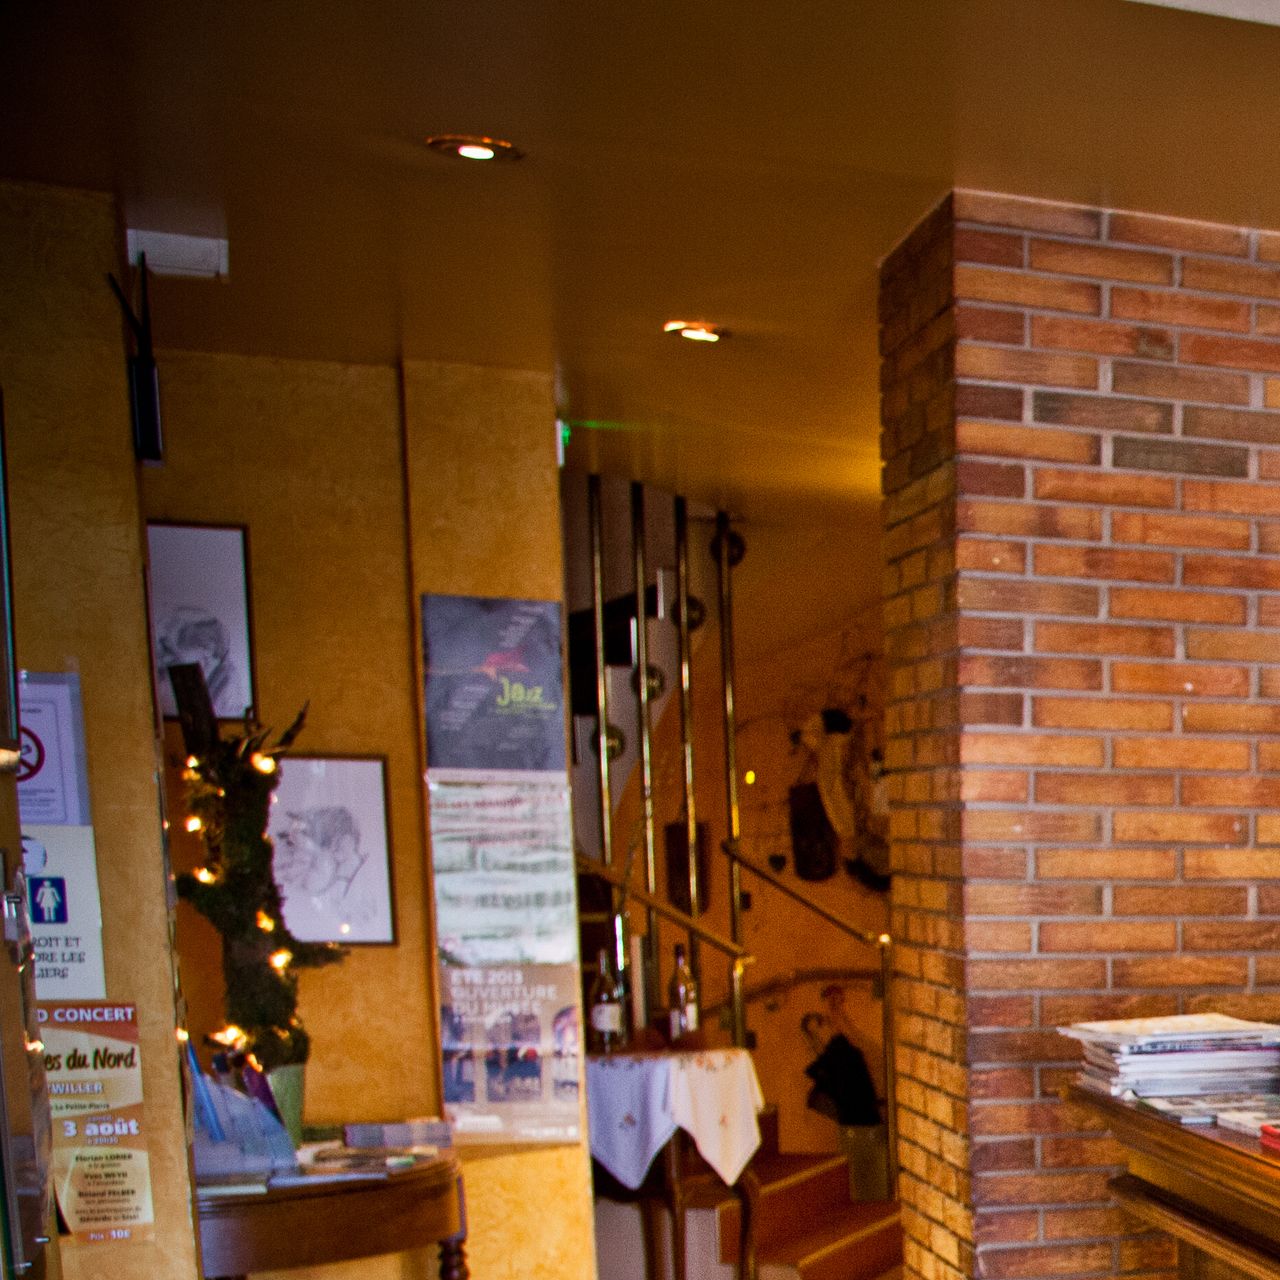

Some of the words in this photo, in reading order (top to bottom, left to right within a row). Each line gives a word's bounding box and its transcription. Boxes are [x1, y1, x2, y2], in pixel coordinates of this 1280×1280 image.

[53, 1007, 134, 1022] CONCERT
[65, 1048, 89, 1071] du
[92, 1046, 137, 1071] Nord
[63, 1120, 77, 1137] 3
[85, 1116, 140, 1137] août
